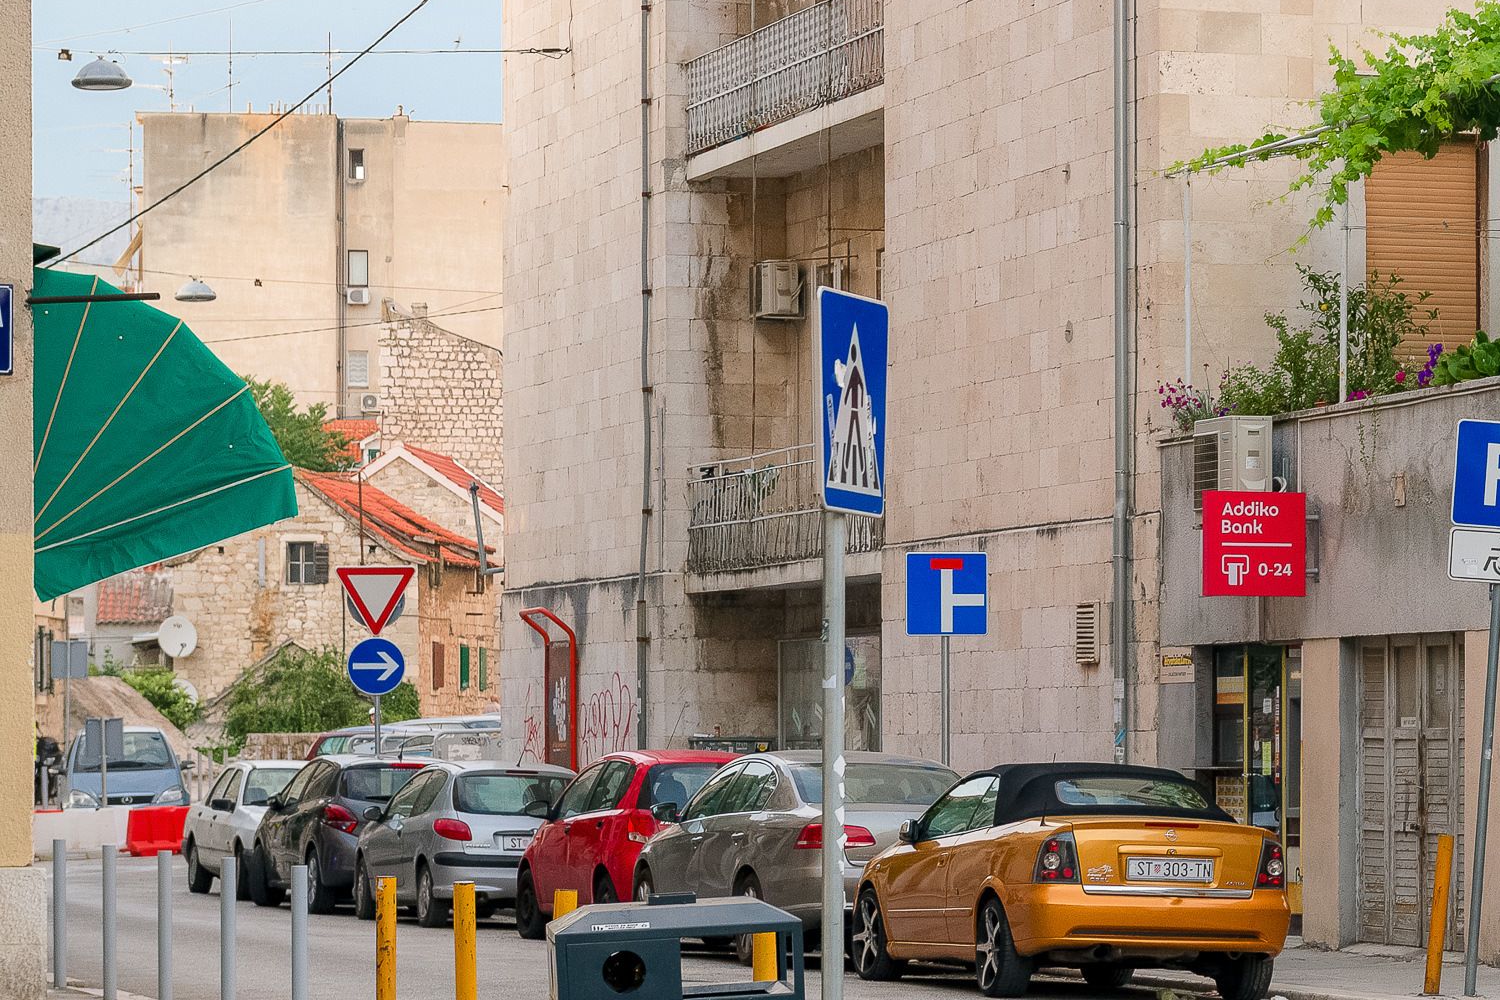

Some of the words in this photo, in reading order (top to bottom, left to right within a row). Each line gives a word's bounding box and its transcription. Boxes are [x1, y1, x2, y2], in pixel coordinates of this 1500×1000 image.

[1222, 501, 1279, 517] Addiko
[1221, 519, 1263, 534] Bank
[1258, 562, 1292, 577] 0-24
[510, 838, 522, 848] ST
[1137, 861, 1153, 876] ST
[1163, 862, 1212, 878] 303-TN
